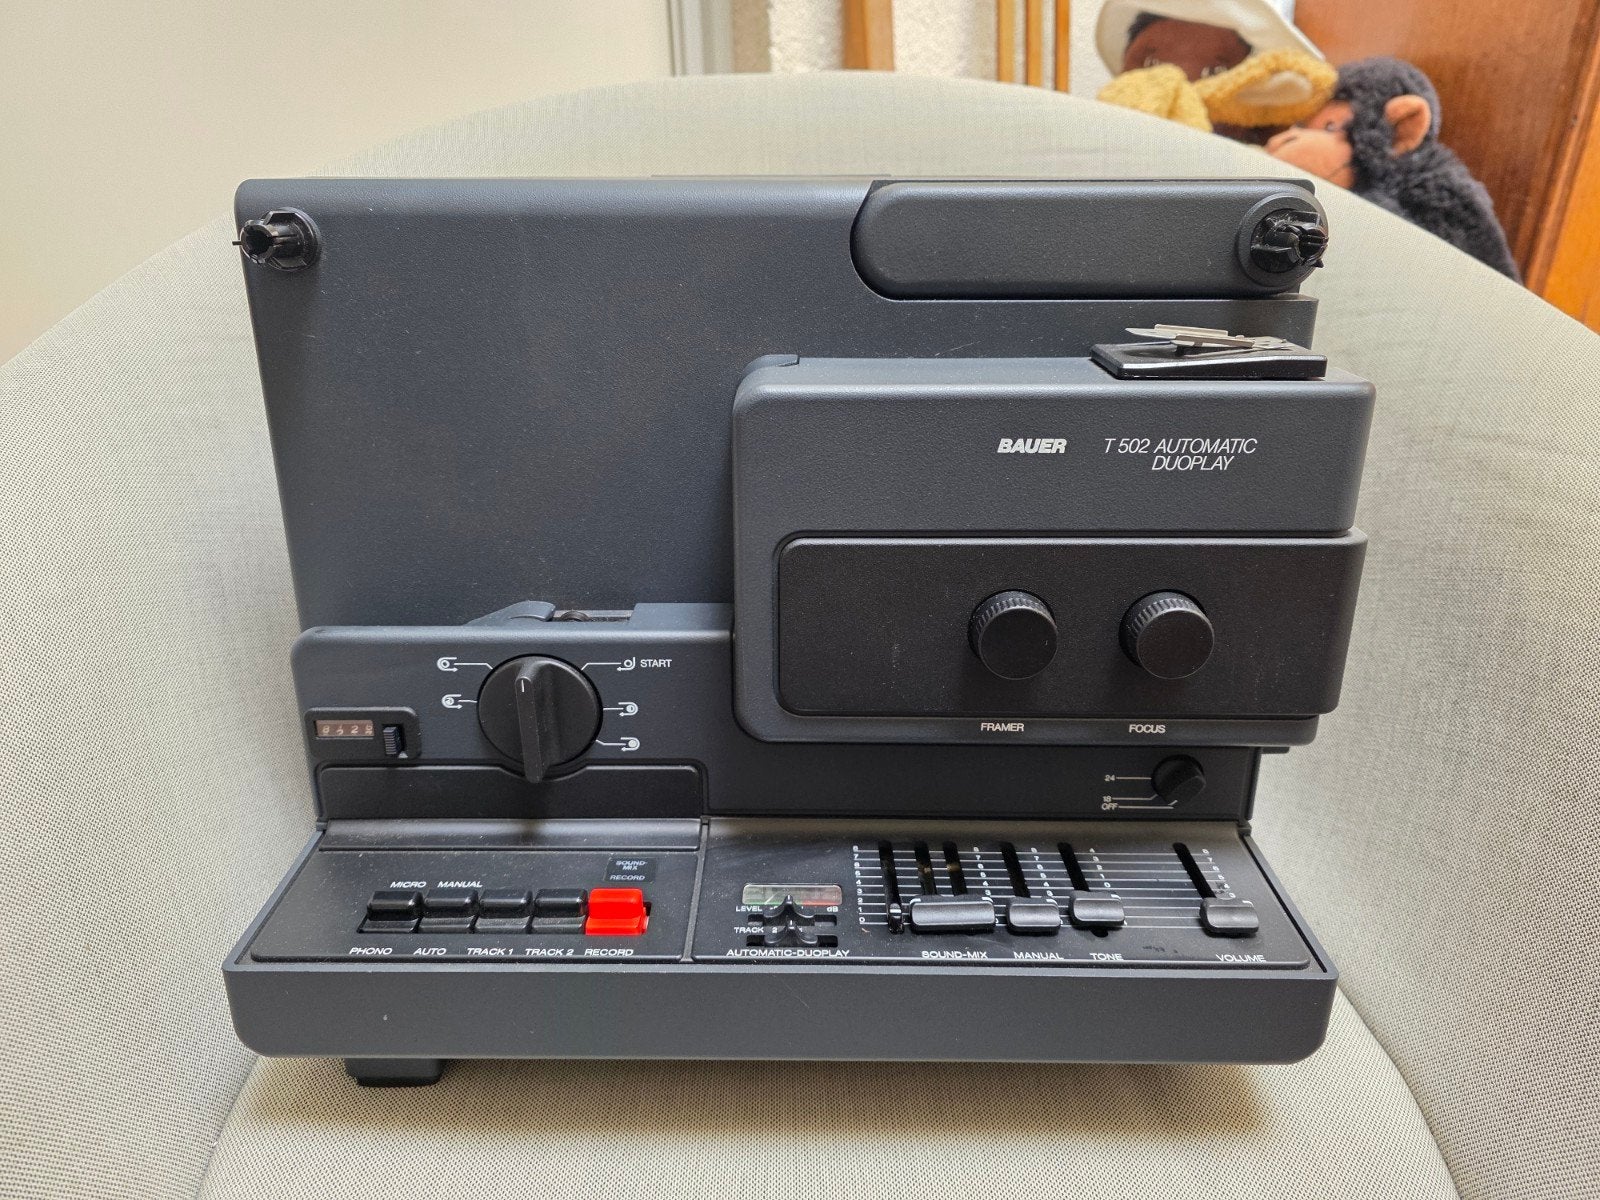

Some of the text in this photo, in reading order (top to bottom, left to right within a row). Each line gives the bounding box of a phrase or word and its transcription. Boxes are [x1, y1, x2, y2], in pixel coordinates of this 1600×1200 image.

[997, 438, 1067, 454] BAUER
[1104, 438, 1258, 454] T 502 AUTOMATIC
[1151, 455, 1235, 471] DUOPLAY
[640, 659, 673, 668] START
[980, 722, 1025, 732] FRAMER
[1129, 723, 1166, 734] FOCUS
[1104, 774, 1115, 782] 24
[1101, 802, 1119, 810] OFF
[733, 926, 764, 934] TRACK
[771, 926, 778, 934] 2
[349, 947, 393, 955] PHONO
[413, 947, 447, 955] AUTO
[466, 947, 514, 956] TRACK 1
[524, 948, 575, 956] TRACK 2
[584, 948, 634, 956] RECORD
[726, 949, 850, 957] AUTOMATIC-DUOPLAY
[921, 951, 988, 960] SOUND-MIX
[1013, 951, 1065, 960] MANUAL
[1089, 952, 1124, 961] TONE
[1215, 954, 1267, 963] VOLUME
